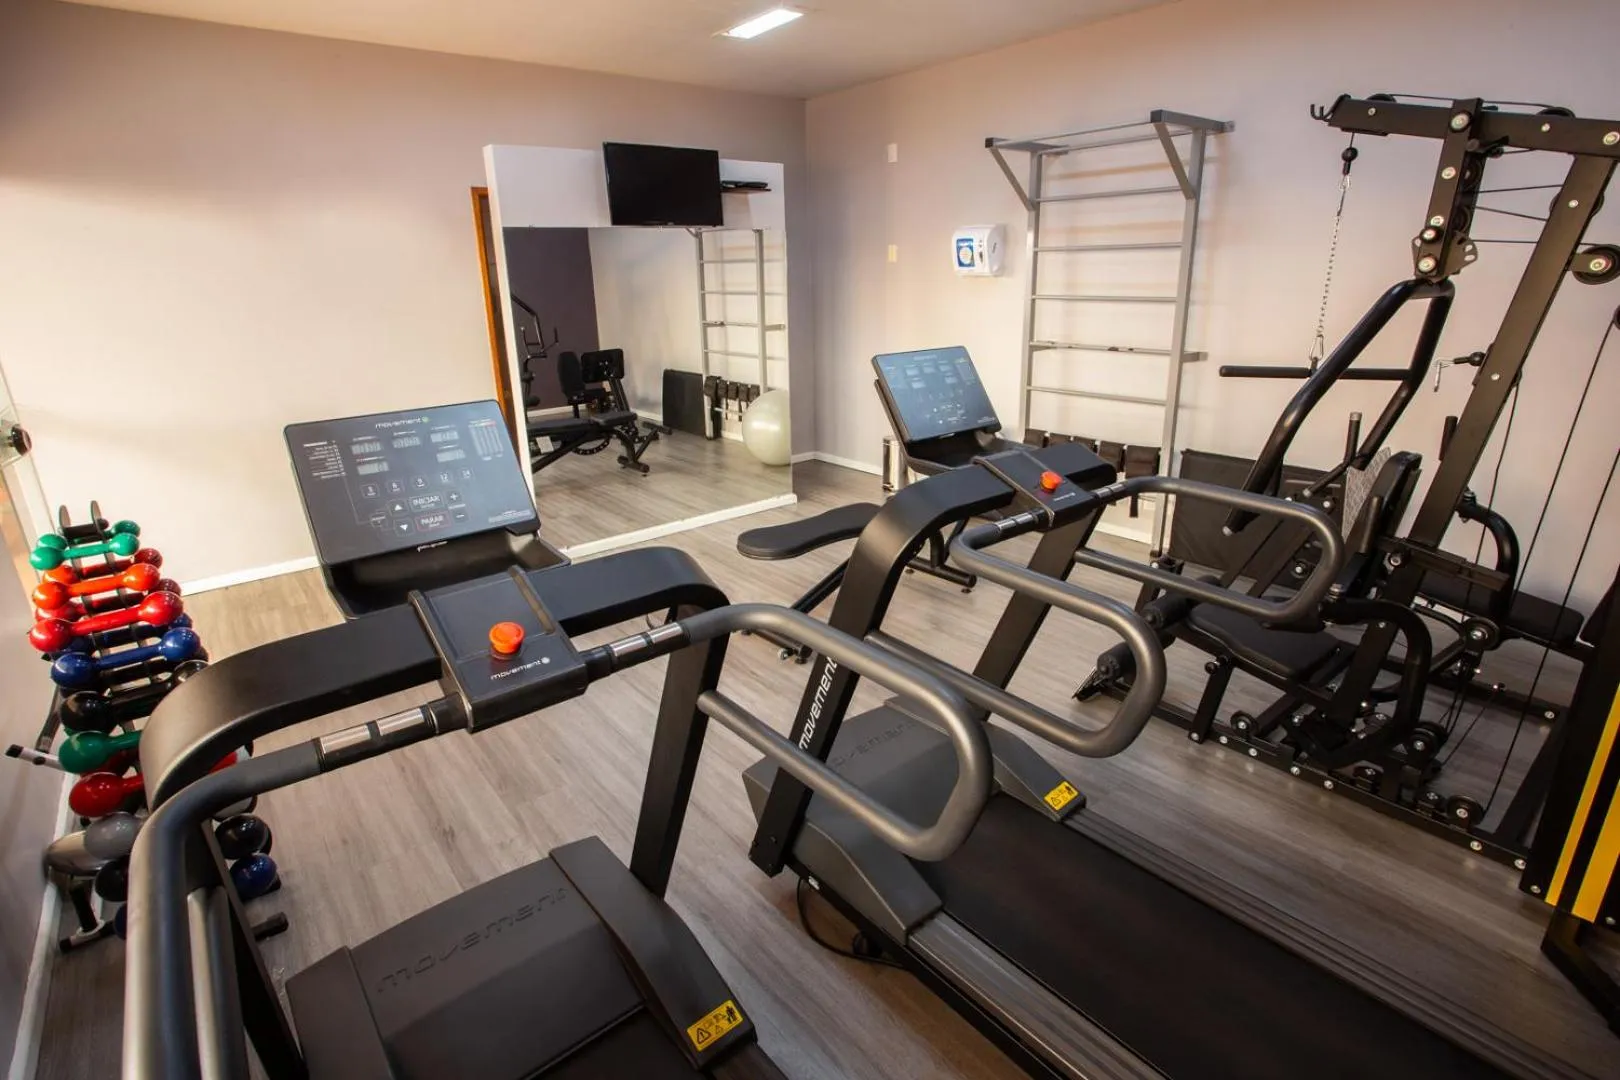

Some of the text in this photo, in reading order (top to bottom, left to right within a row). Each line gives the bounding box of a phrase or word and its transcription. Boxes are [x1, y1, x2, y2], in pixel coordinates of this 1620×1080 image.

[375, 417, 421, 430] movement
[490, 659, 541, 681] movement
[798, 655, 838, 751] movement
[376, 887, 569, 994] movement
